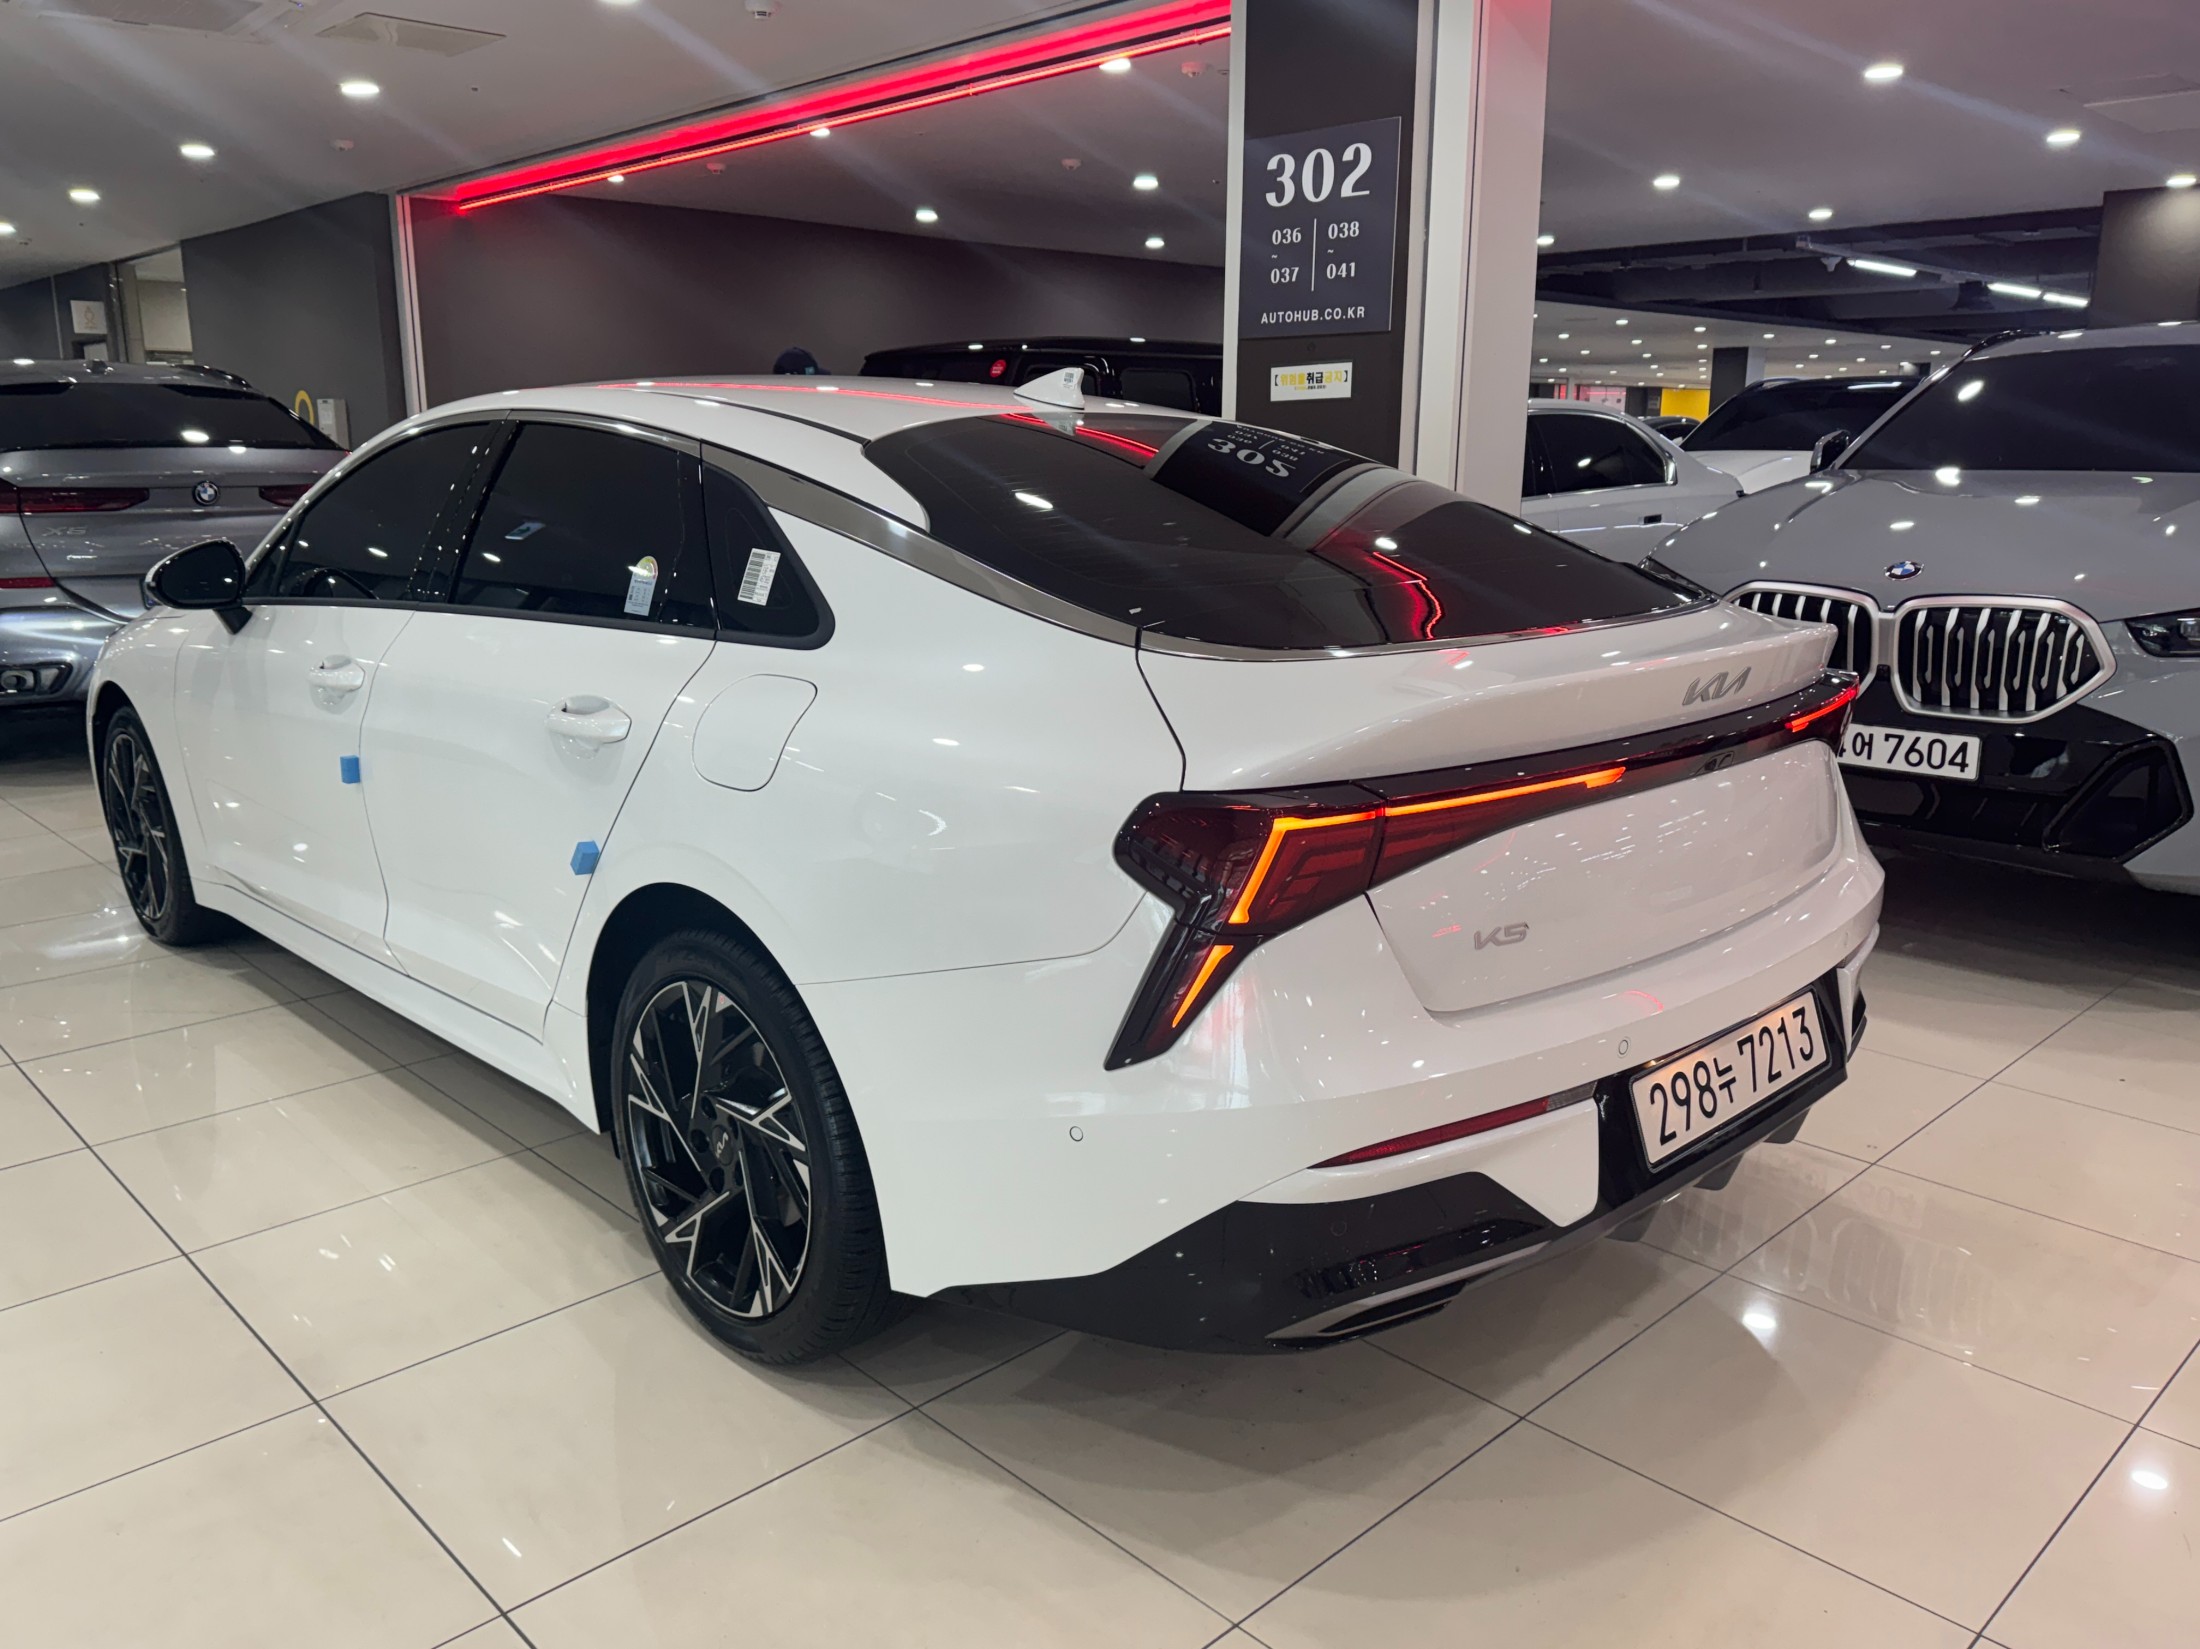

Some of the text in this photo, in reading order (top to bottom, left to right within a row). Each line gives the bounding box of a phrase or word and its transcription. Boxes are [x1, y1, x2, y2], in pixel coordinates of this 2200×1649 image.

[1265, 143, 1372, 207] 302
[1271, 227, 1302, 245] 036
[1328, 221, 1360, 239] 038
[1270, 267, 1299, 284] 037
[1326, 262, 1356, 279] 041
[1260, 306, 1366, 324] AUTOHUB.CO.KR
[1884, 733, 1969, 773] 7604
[1473, 921, 1529, 950] K5
[1650, 1006, 1815, 1146] 298누 7213
